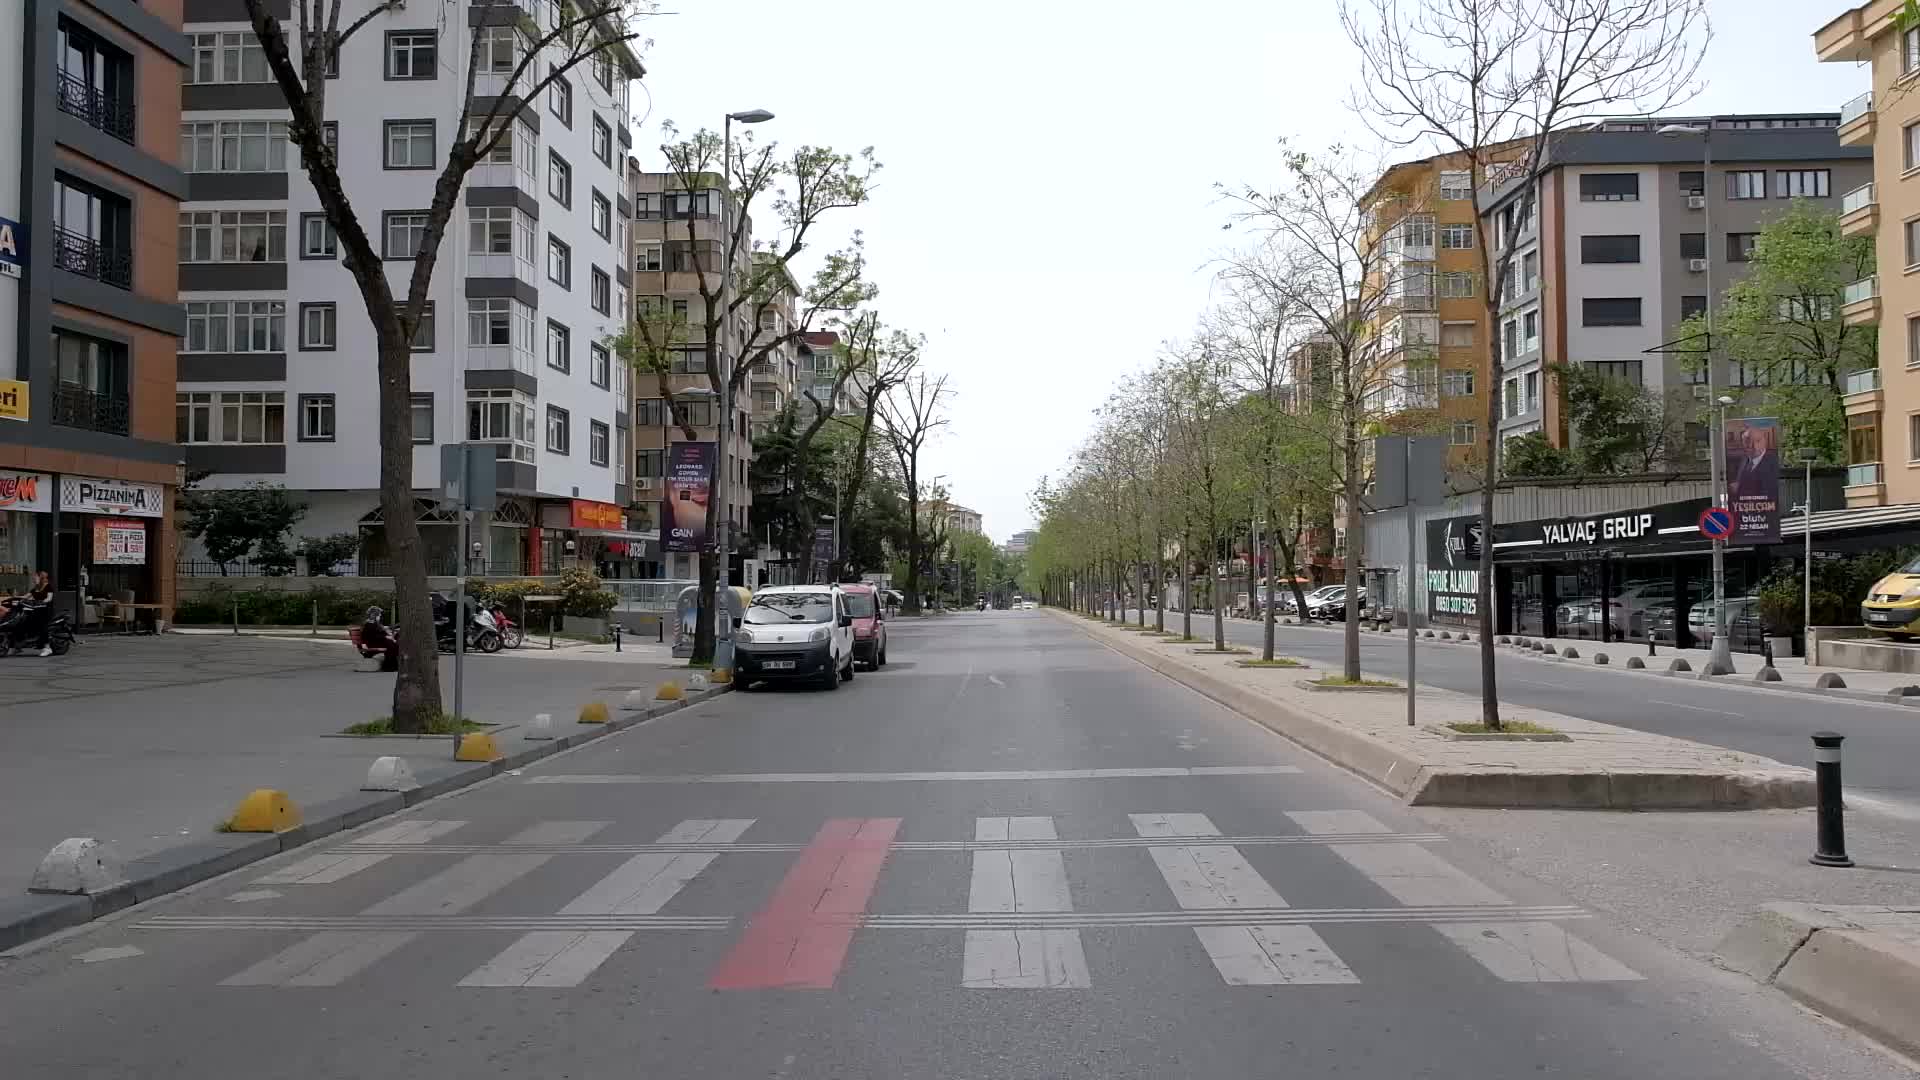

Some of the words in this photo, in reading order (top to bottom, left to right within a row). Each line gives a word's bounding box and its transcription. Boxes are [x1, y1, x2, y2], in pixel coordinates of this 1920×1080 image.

[0, 388, 17, 407] ri
[1543, 521, 1596, 544] YALVAÇ
[1603, 514, 1652, 540] GRUP
[1428, 569, 1449, 592] PROJE
[1450, 570, 1482, 594] ALANIDI
[1435, 595, 1450, 611] 0850
[1450, 596, 1461, 611] 307
